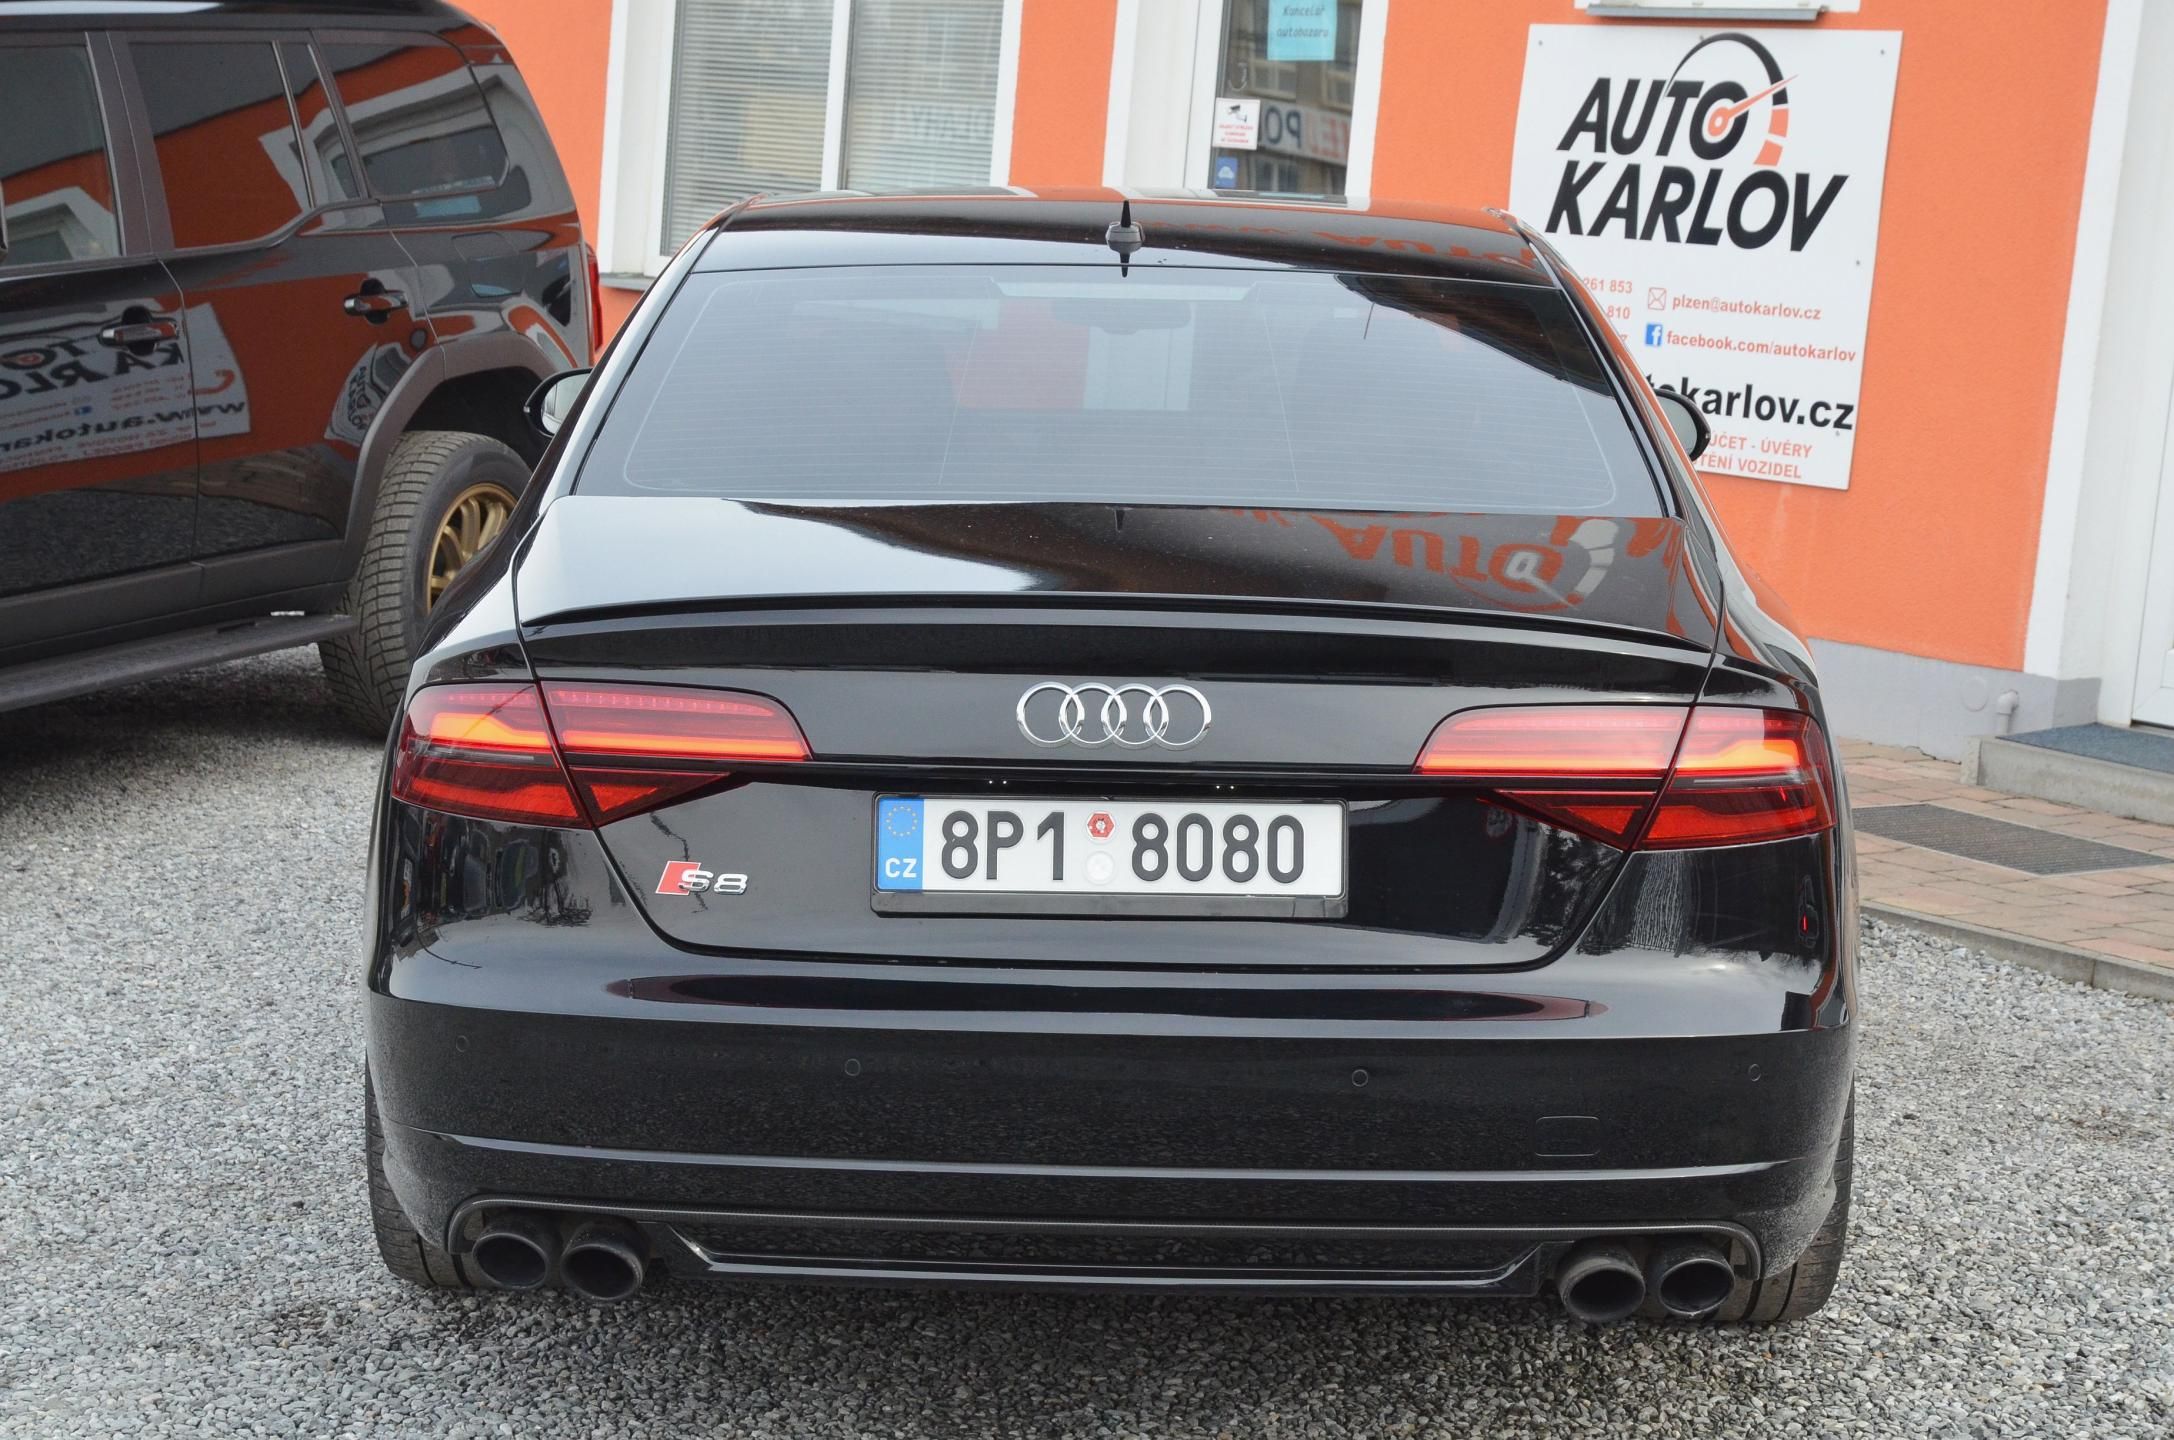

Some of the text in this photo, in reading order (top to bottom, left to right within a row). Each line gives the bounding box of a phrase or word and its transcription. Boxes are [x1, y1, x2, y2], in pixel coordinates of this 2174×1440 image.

[1556, 77, 1750, 160] AUTO
[1545, 160, 1850, 252] KARLOV
[1609, 280, 1633, 294] 853
[1672, 294, 1822, 320] plzen@autokarlov.cz
[1667, 330, 1857, 362] facebook.com/autokarlov
[1694, 452, 1802, 479] TĚNÍ VOZIDEL
[941, 810, 1305, 884] 8P1 8080
[885, 857, 917, 879] CZ
[677, 869, 748, 895] S8
